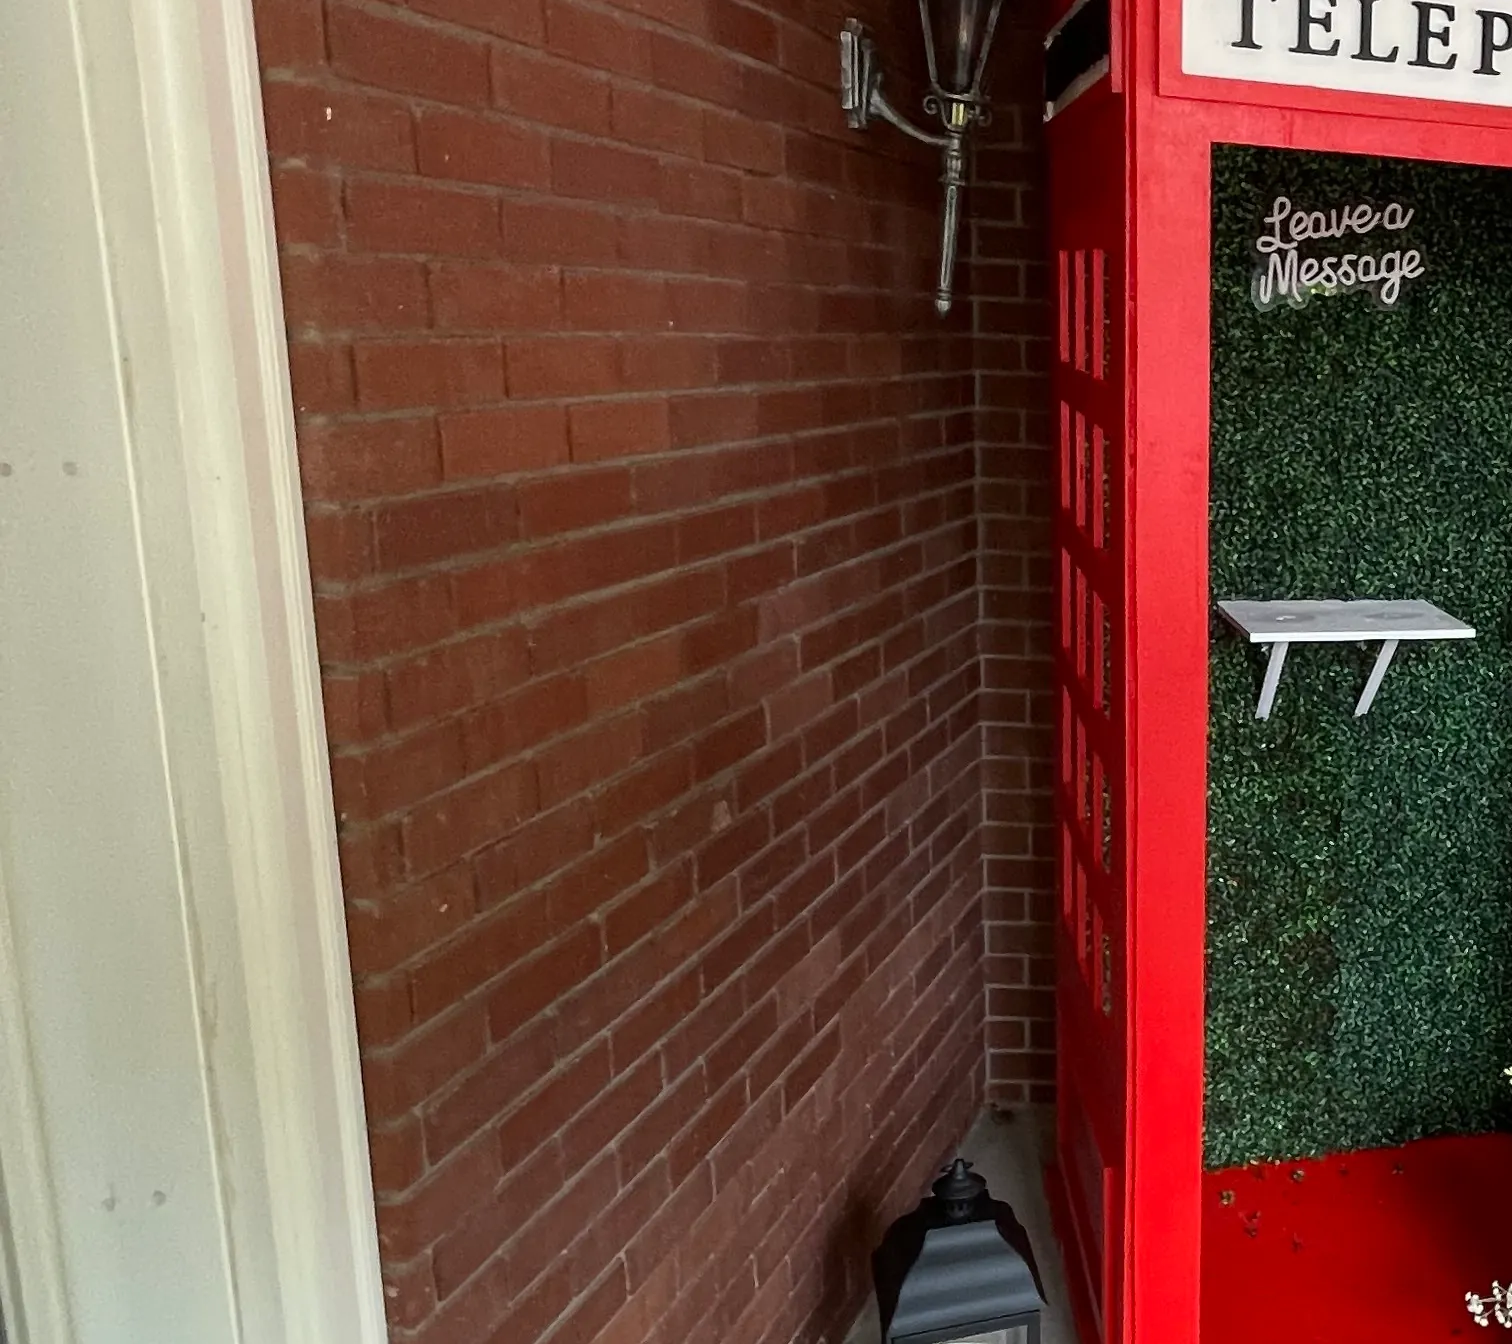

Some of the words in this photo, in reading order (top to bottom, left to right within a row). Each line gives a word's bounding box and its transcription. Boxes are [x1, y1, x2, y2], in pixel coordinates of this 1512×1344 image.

[1256, 196, 1382, 253] Leave
[1383, 202, 1415, 230] a
[1259, 249, 1426, 305] Message
